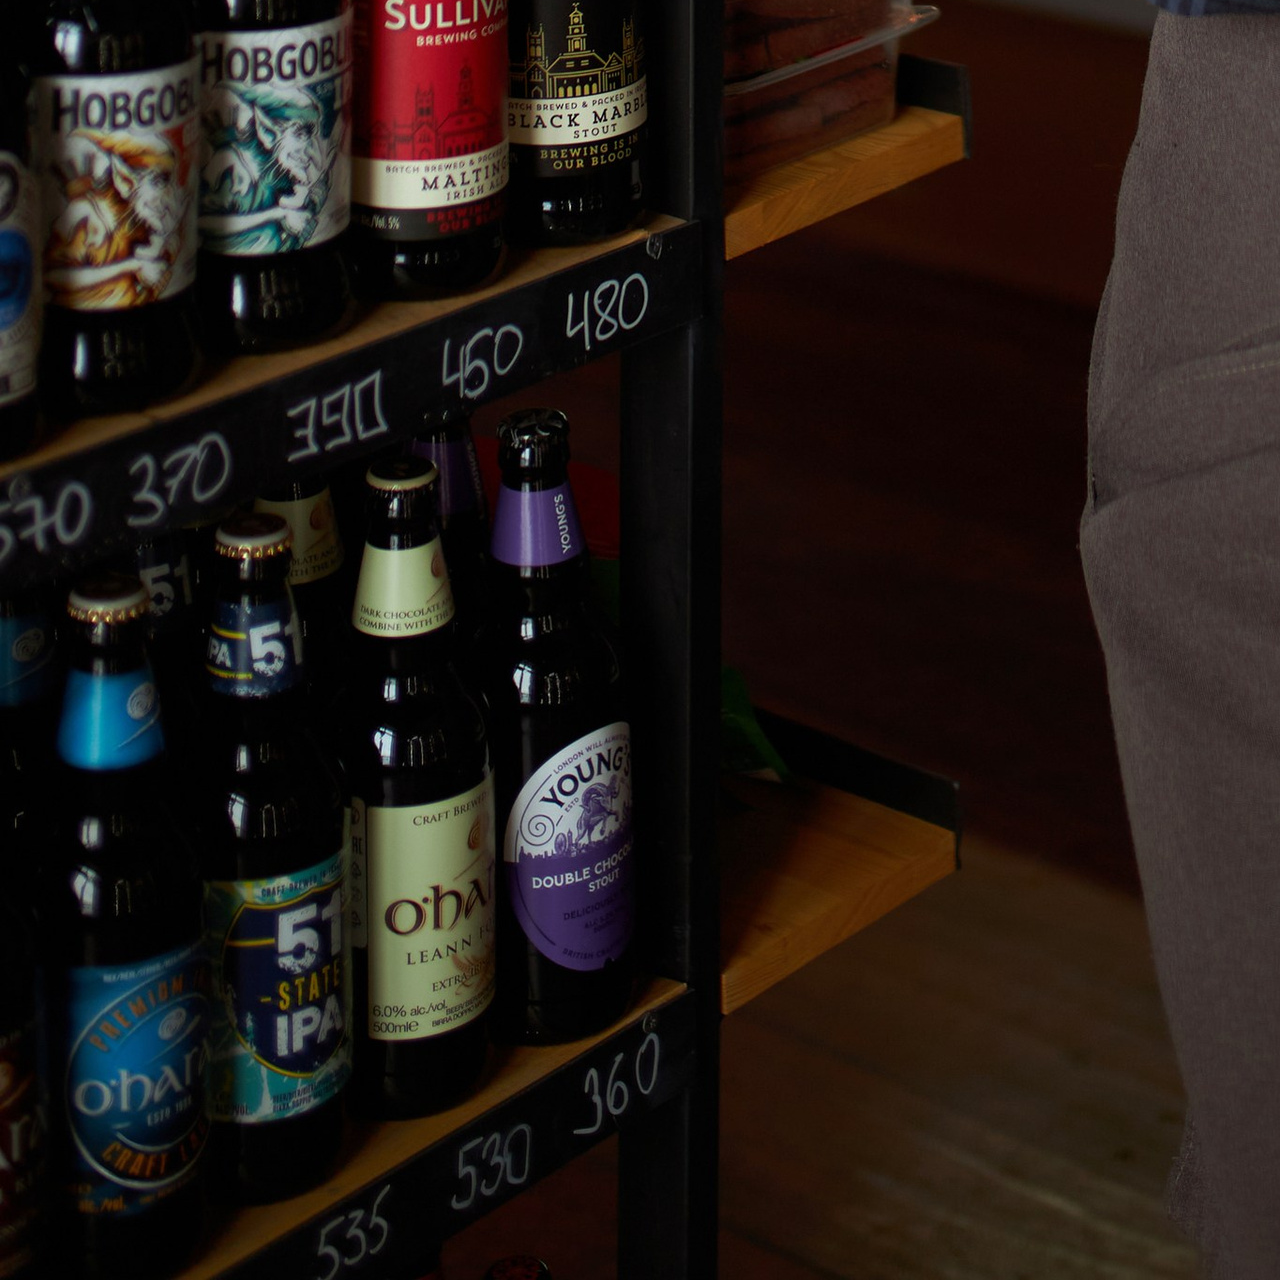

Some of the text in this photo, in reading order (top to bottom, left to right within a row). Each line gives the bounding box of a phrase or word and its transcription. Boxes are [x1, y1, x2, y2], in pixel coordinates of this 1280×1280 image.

[416, 28, 478, 48] BREWING
[536, 102, 578, 111] BREWED
[581, 100, 588, 108] &
[592, 90, 625, 107] PACKED
[508, 112, 581, 129] BLACK
[573, 123, 618, 139] STOUT
[540, 143, 609, 159] BREWING
[613, 138, 625, 151] IS
[552, 147, 633, 171] OUR BLOOD
[385, 165, 420, 174] BATCH
[424, 161, 465, 173] BREWED
[446, 184, 485, 202] IRISH
[125, 429, 232, 528] 370
[286, 367, 390, 464] 390
[565, 271, 650, 352] 480
[553, 493, 572, 555] YOUNG'S
[138, 552, 193, 617] 51
[360, 604, 381, 618] DARK
[383, 602, 443, 620] CHOCOLATE
[359, 617, 401, 632] COMBINE
[404, 617, 433, 630] WITH
[249, 620, 304, 677] 51
[553, 749, 584, 775] LONDON
[584, 741, 603, 753] WILL
[539, 743, 631, 808] YOUNG'S
[413, 790, 488, 826] CRAFT BREWED
[564, 796, 580, 813] ESTD
[532, 866, 591, 890] DOUBLE
[588, 868, 620, 893] STOUT
[261, 884, 287, 898] CRAFT
[276, 887, 343, 975] 51
[406, 933, 473, 967] LEANN
[562, 947, 594, 960] BRITISH
[277, 958, 341, 1011] STATE
[431, 971, 468, 993] EXTRA
[88, 972, 185, 1053] PREMIUM
[372, 1004, 407, 1019] 6.0%
[276, 993, 345, 1057] IPA
[101, 1140, 170, 1177] CRAFT
[316, 1032, 660, 1280] 535 530 360
